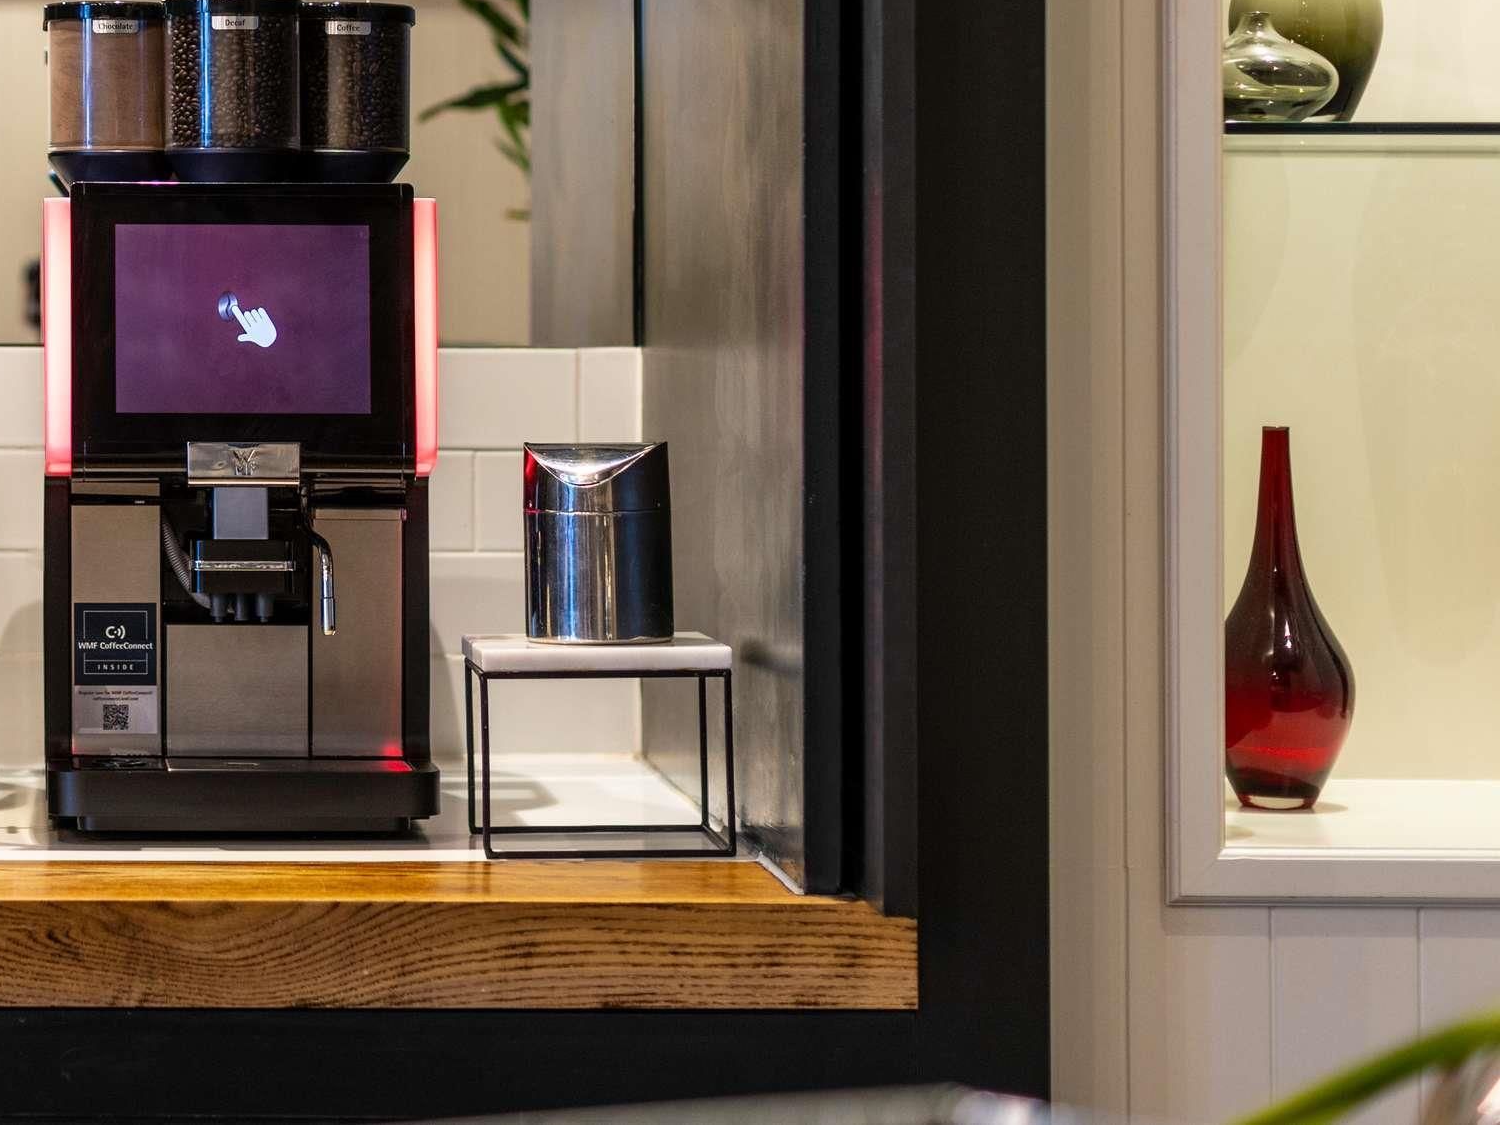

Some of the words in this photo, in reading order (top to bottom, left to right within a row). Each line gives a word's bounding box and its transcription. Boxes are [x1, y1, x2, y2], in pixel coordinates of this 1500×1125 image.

[98, 22, 134, 31] Chocolate
[225, 18, 247, 27] Decaf
[336, 23, 361, 32] Coffee
[78, 642, 98, 650] WMF
[100, 642, 153, 650] CoffeeConnect
